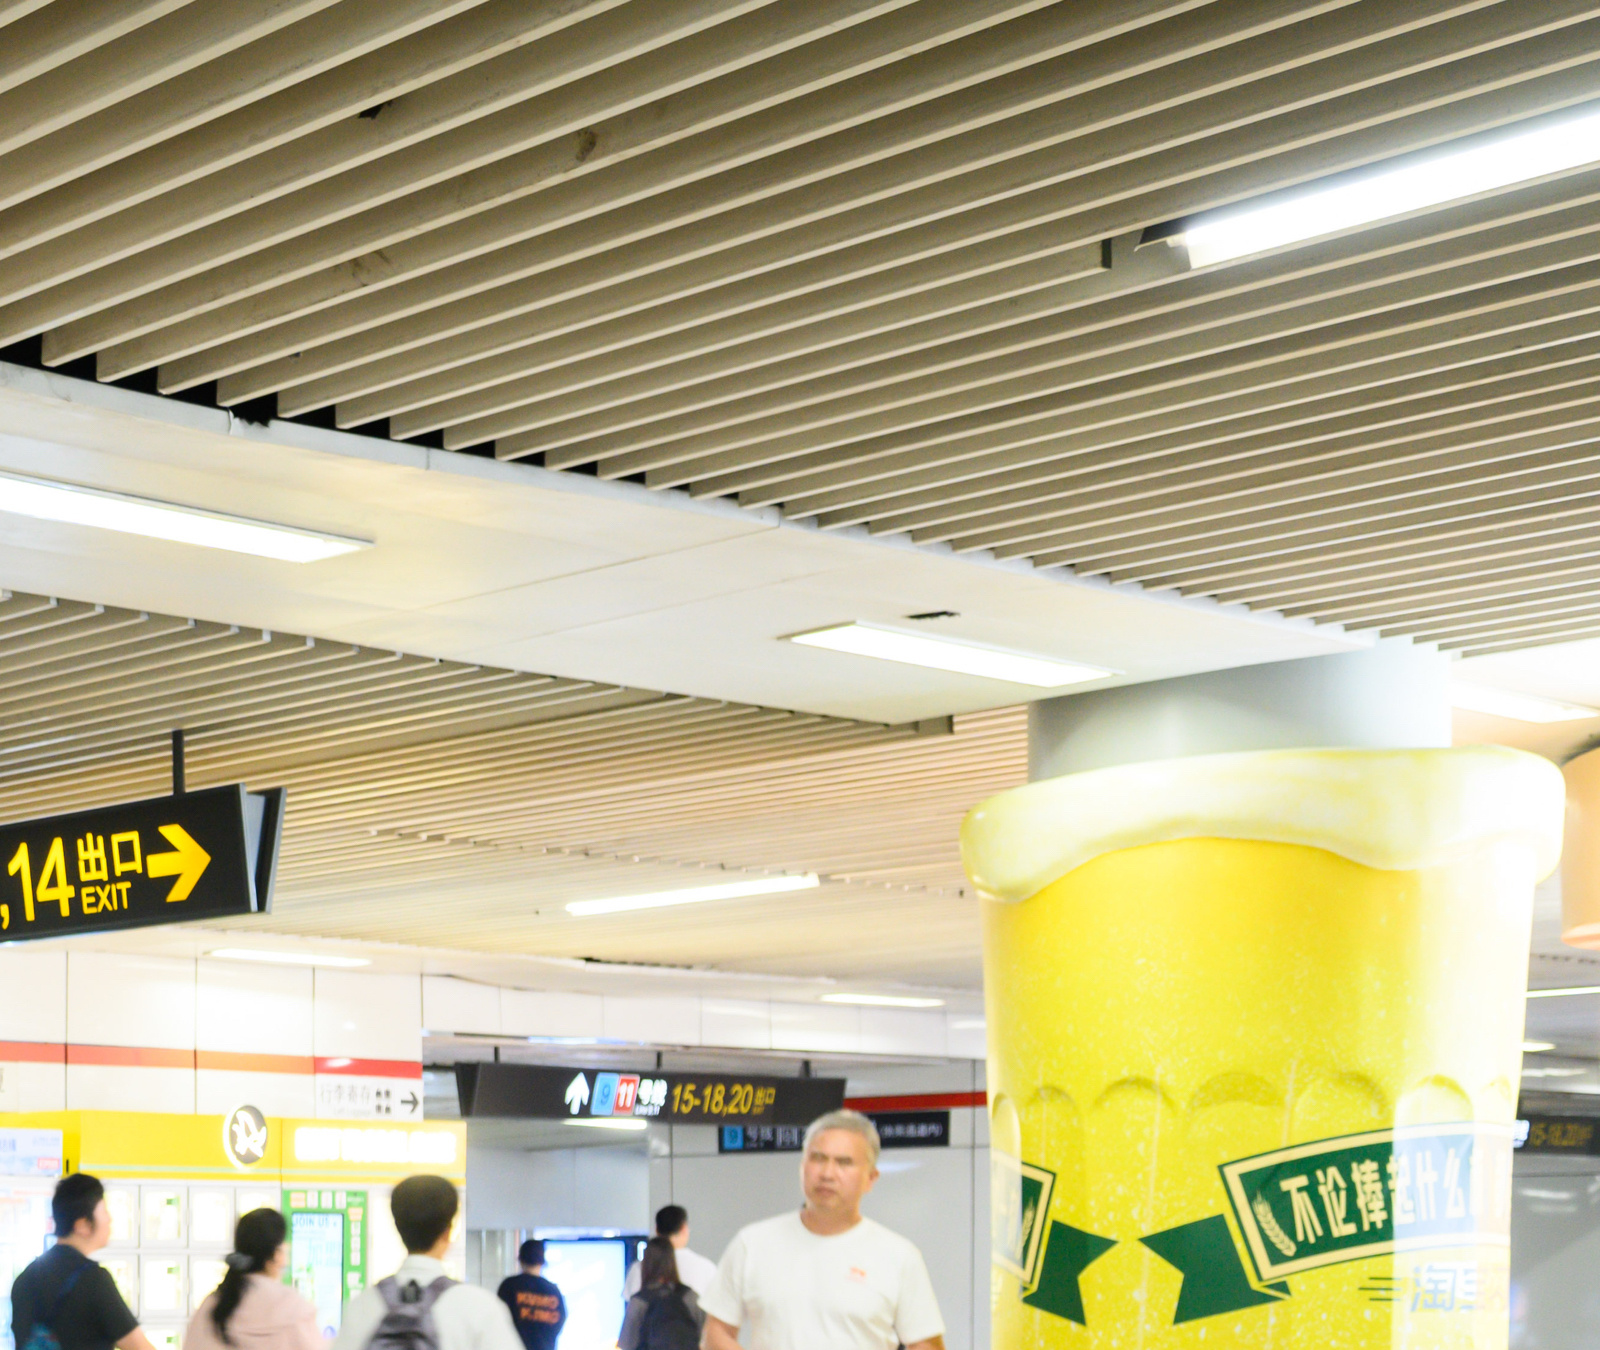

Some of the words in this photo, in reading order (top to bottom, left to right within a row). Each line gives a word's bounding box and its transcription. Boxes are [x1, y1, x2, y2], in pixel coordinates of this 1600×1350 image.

[77, 830, 143, 881] 出口
[81, 881, 132, 914] EXIT
[617, 1082, 635, 1107] 11
[672, 1083, 754, 1117] 15-18,20
